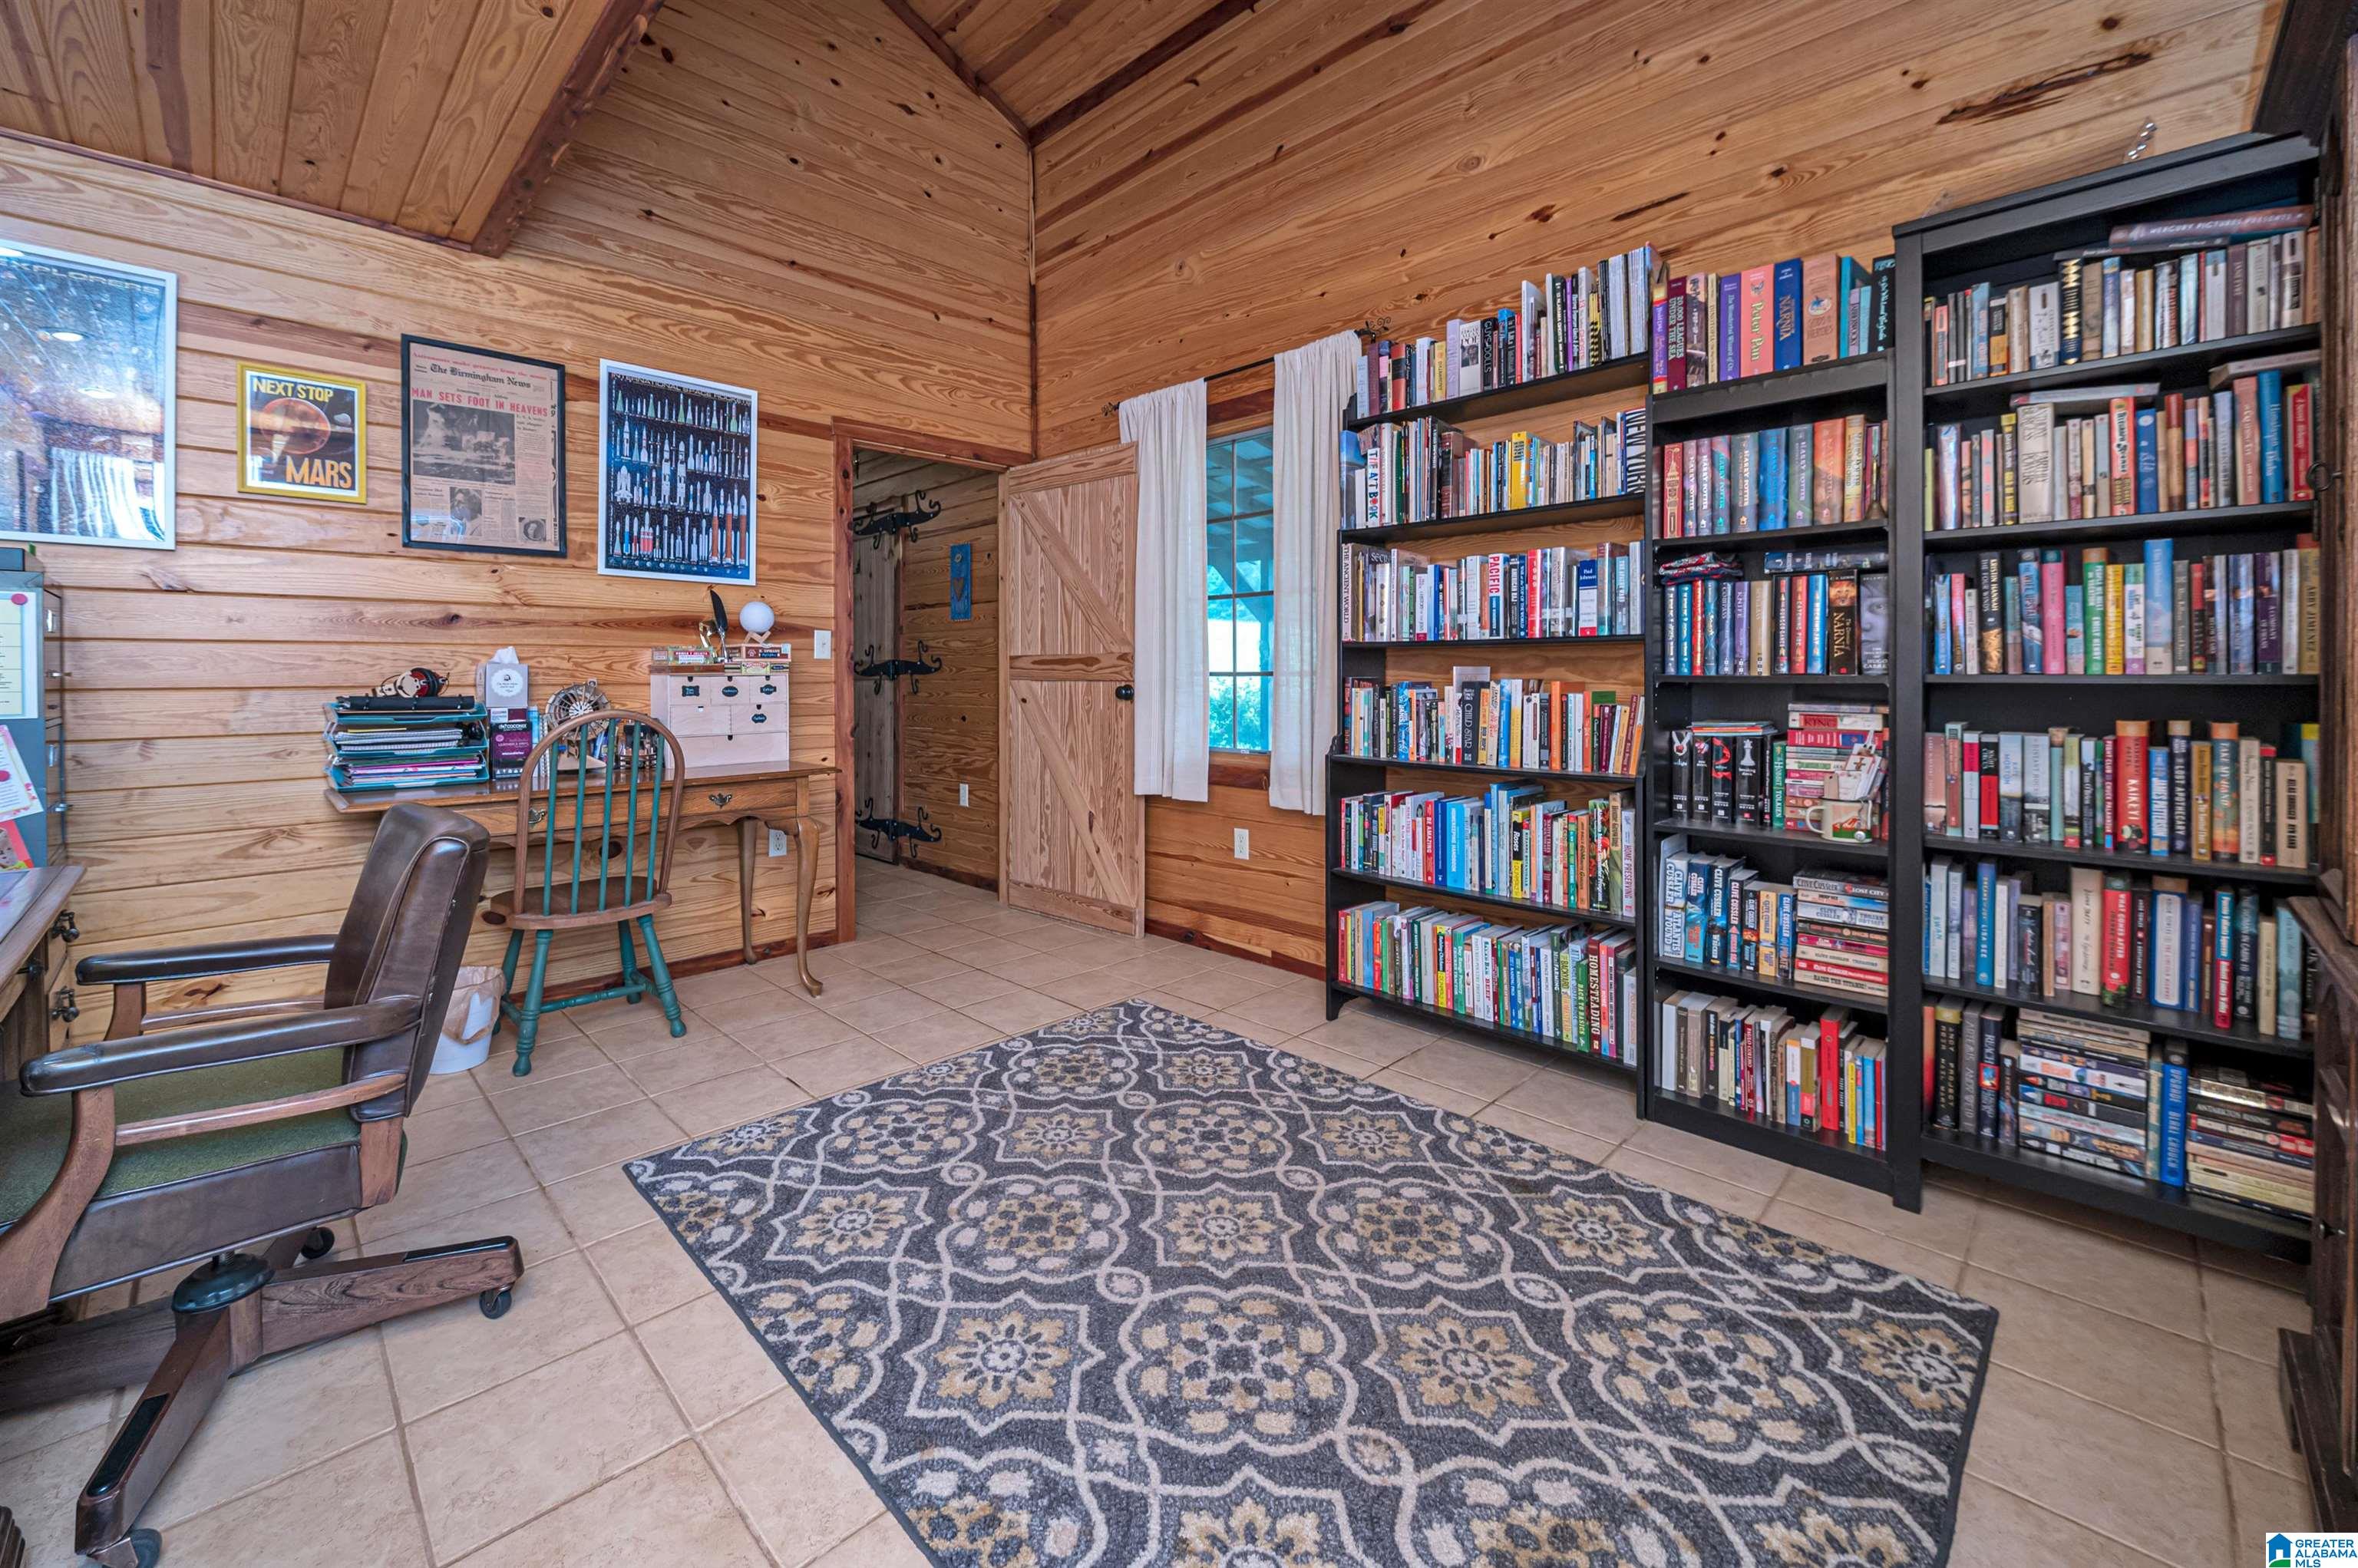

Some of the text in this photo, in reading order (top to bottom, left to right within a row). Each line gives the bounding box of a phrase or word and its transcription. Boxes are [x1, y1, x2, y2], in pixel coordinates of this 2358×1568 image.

[1751, 302, 1764, 361] Peter Pan
[1780, 295, 1792, 342] NARNIA
[430, 363, 531, 388] The Birmingham News
[1484, 347, 1492, 373] DOLLS
[253, 378, 334, 402] NEXT STOP
[411, 388, 432, 399] MAN
[439, 391, 461, 404] SETS
[467, 395, 490, 408] FOOT
[495, 399, 504, 410] IN
[510, 403, 548, 417] HEAVENS
[610, 372, 682, 392] INTERNATIONAL
[682, 387, 712, 398] SPACE
[1626, 411, 1646, 447] NEW
[286, 455, 352, 489] MARS
[1369, 451, 1379, 519] THE BOOK
[1489, 556, 1500, 594] PACIFIC
[1990, 559, 1999, 611] KRISTIN HANNAH
[1833, 612, 1844, 657] NARNIA
[2092, 639, 2102, 660] HENRY
[2306, 611, 2317, 652] JIMENEZ
[1775, 761, 1784, 786] HOBBIT
[2152, 778, 2168, 837] JAMES PATTERSON
[2175, 765, 2185, 836] LOST APOTHECARY
[1624, 845, 1633, 899] HOME PRESERVING
[1666, 863, 1683, 903] CLIVE CUSSLER
[1797, 878, 1813, 888] CLIVE
[1814, 880, 1838, 891] CUSSLER
[1730, 882, 1739, 924] CLIVE CUSSLER
[1665, 917, 1673, 945] FOUND
[1673, 912, 1682, 951] ATLANTIS
[1560, 960, 1569, 989] BACKYARD
[1588, 955, 1600, 1035] HOMESTEADING
[1966, 1021, 1974, 1060] ARTEMIS
[2170, 1069, 2182, 1103] UPGRADE
[2168, 1111, 2181, 1168] BLAKE CROUCH
